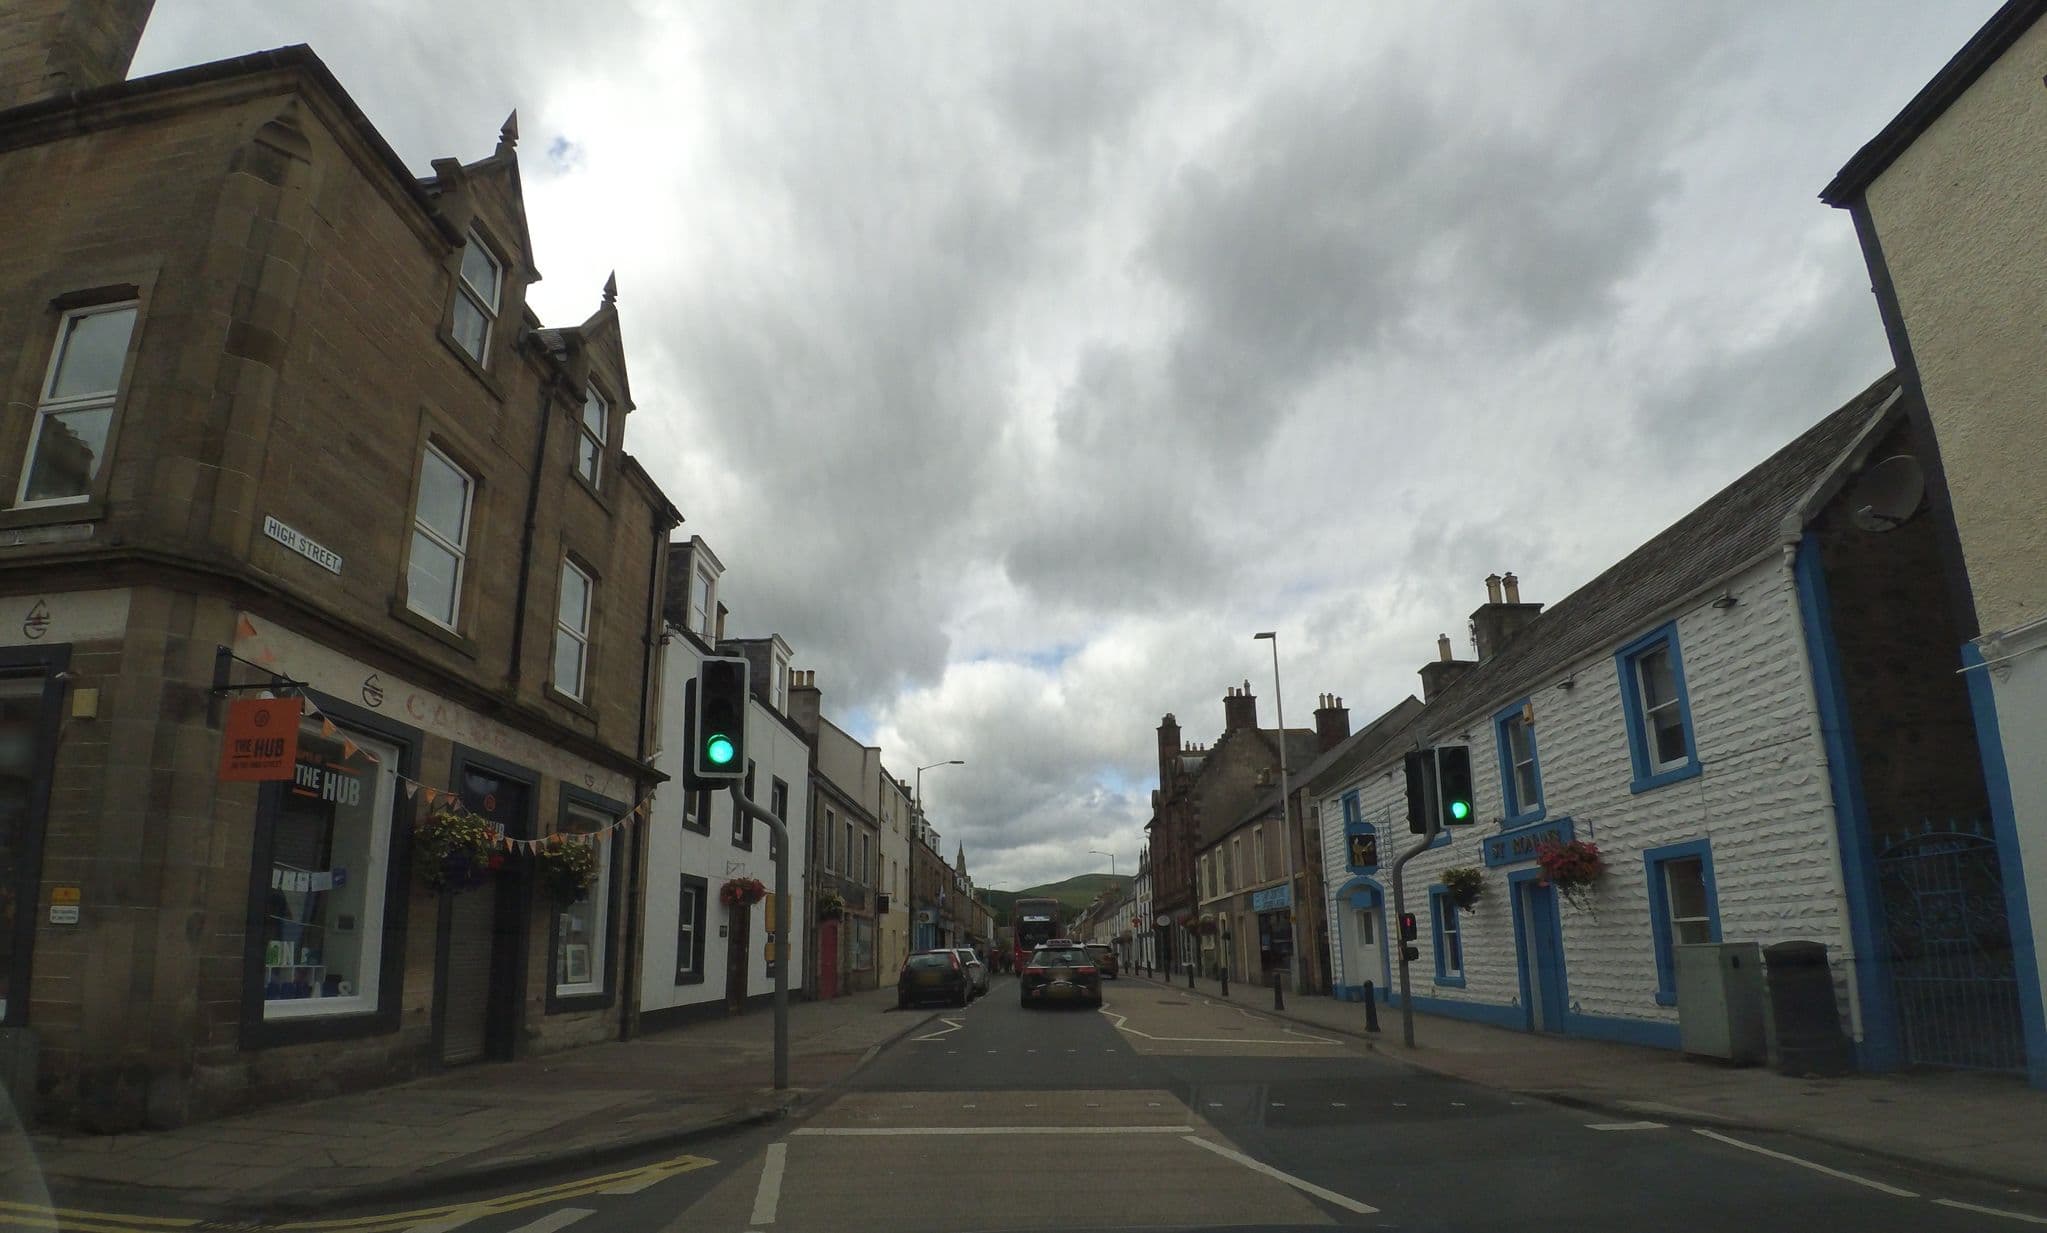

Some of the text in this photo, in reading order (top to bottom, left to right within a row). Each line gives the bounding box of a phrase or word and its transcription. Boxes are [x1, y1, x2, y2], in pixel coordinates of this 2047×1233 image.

[268, 520, 338, 570] HIGH STREET
[235, 739, 253, 754] THE
[254, 737, 285, 758] HUB
[296, 764, 361, 807] THE HUB
